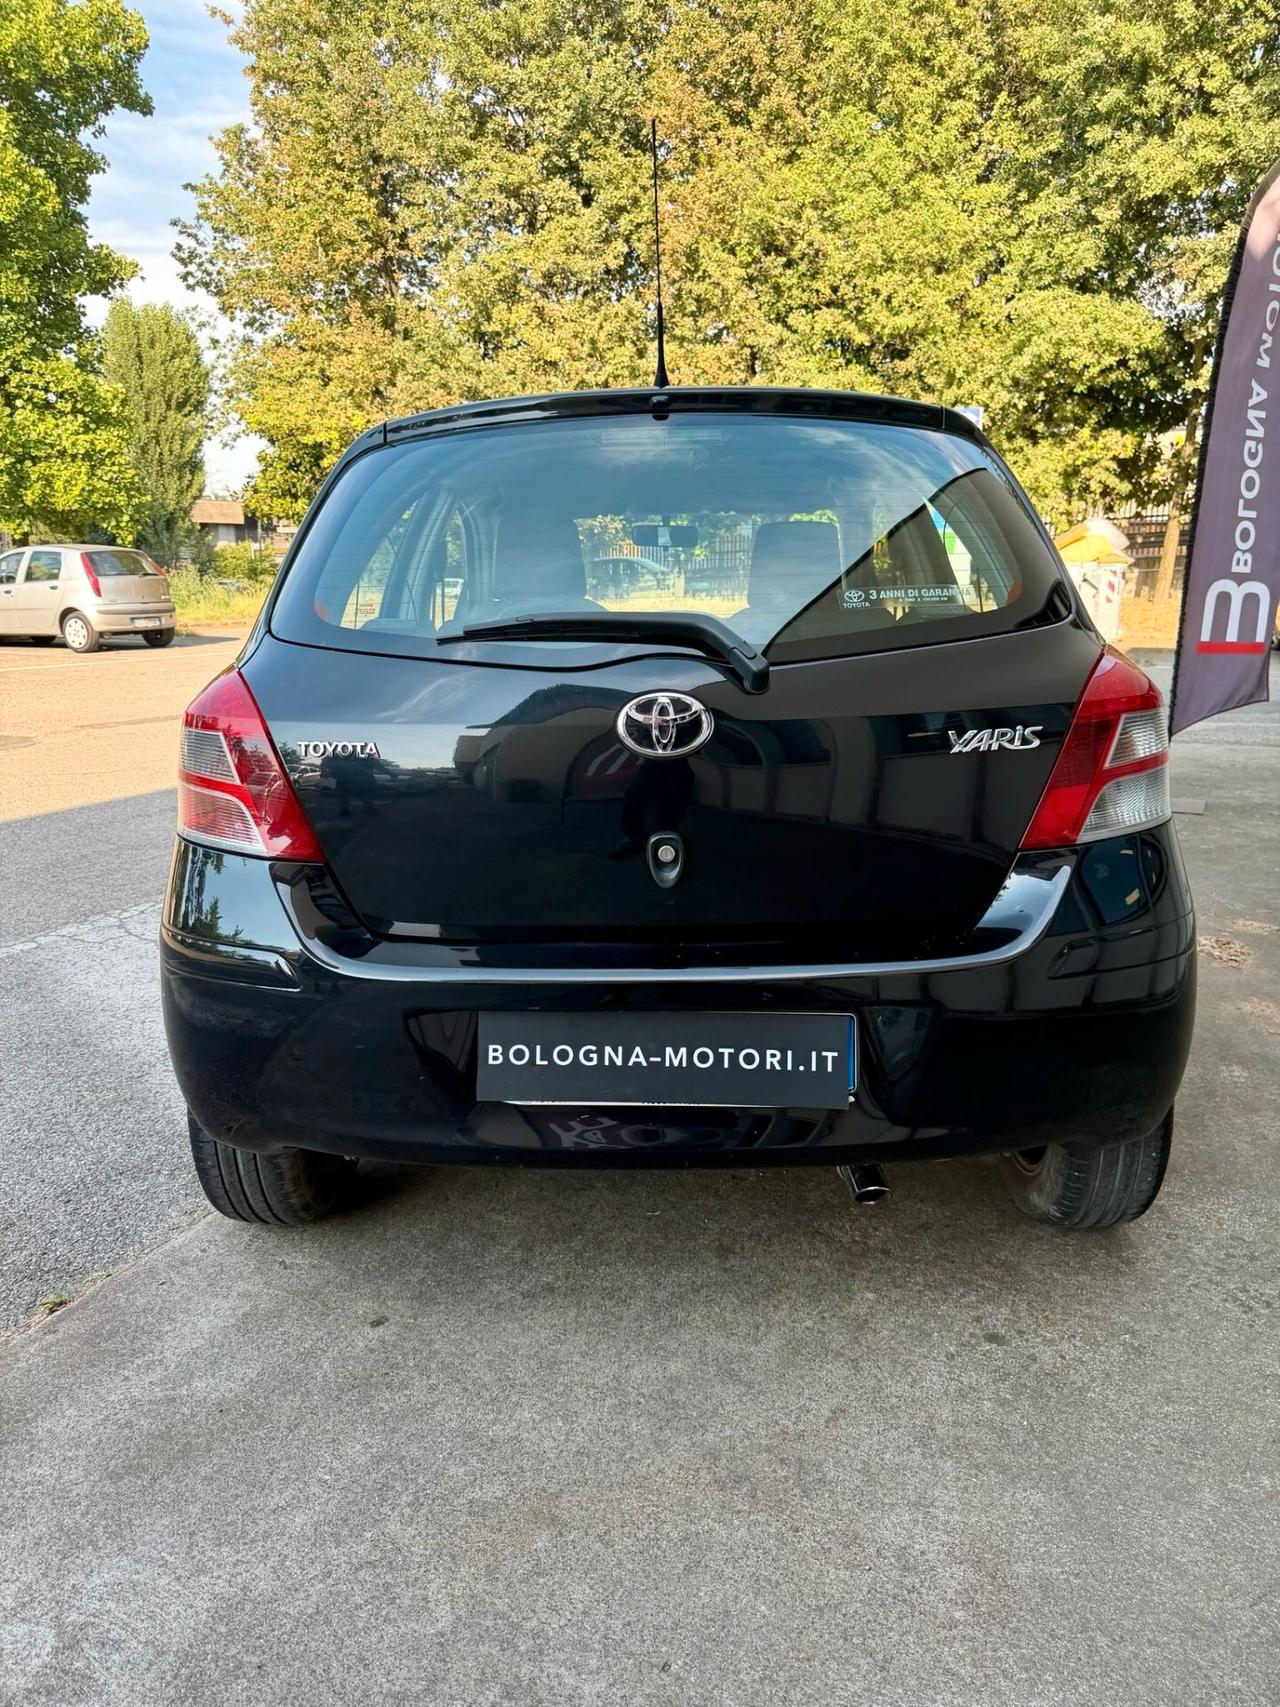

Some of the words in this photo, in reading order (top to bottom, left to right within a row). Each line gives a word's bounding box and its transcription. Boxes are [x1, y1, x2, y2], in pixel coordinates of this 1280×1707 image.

[868, 590, 877, 600] 3
[879, 590, 905, 599] ANNI
[907, 589, 919, 597] DI
[297, 741, 380, 758] TOYOTA
[487, 1044, 839, 1073] BOLOGNA-MOTORI.IT
